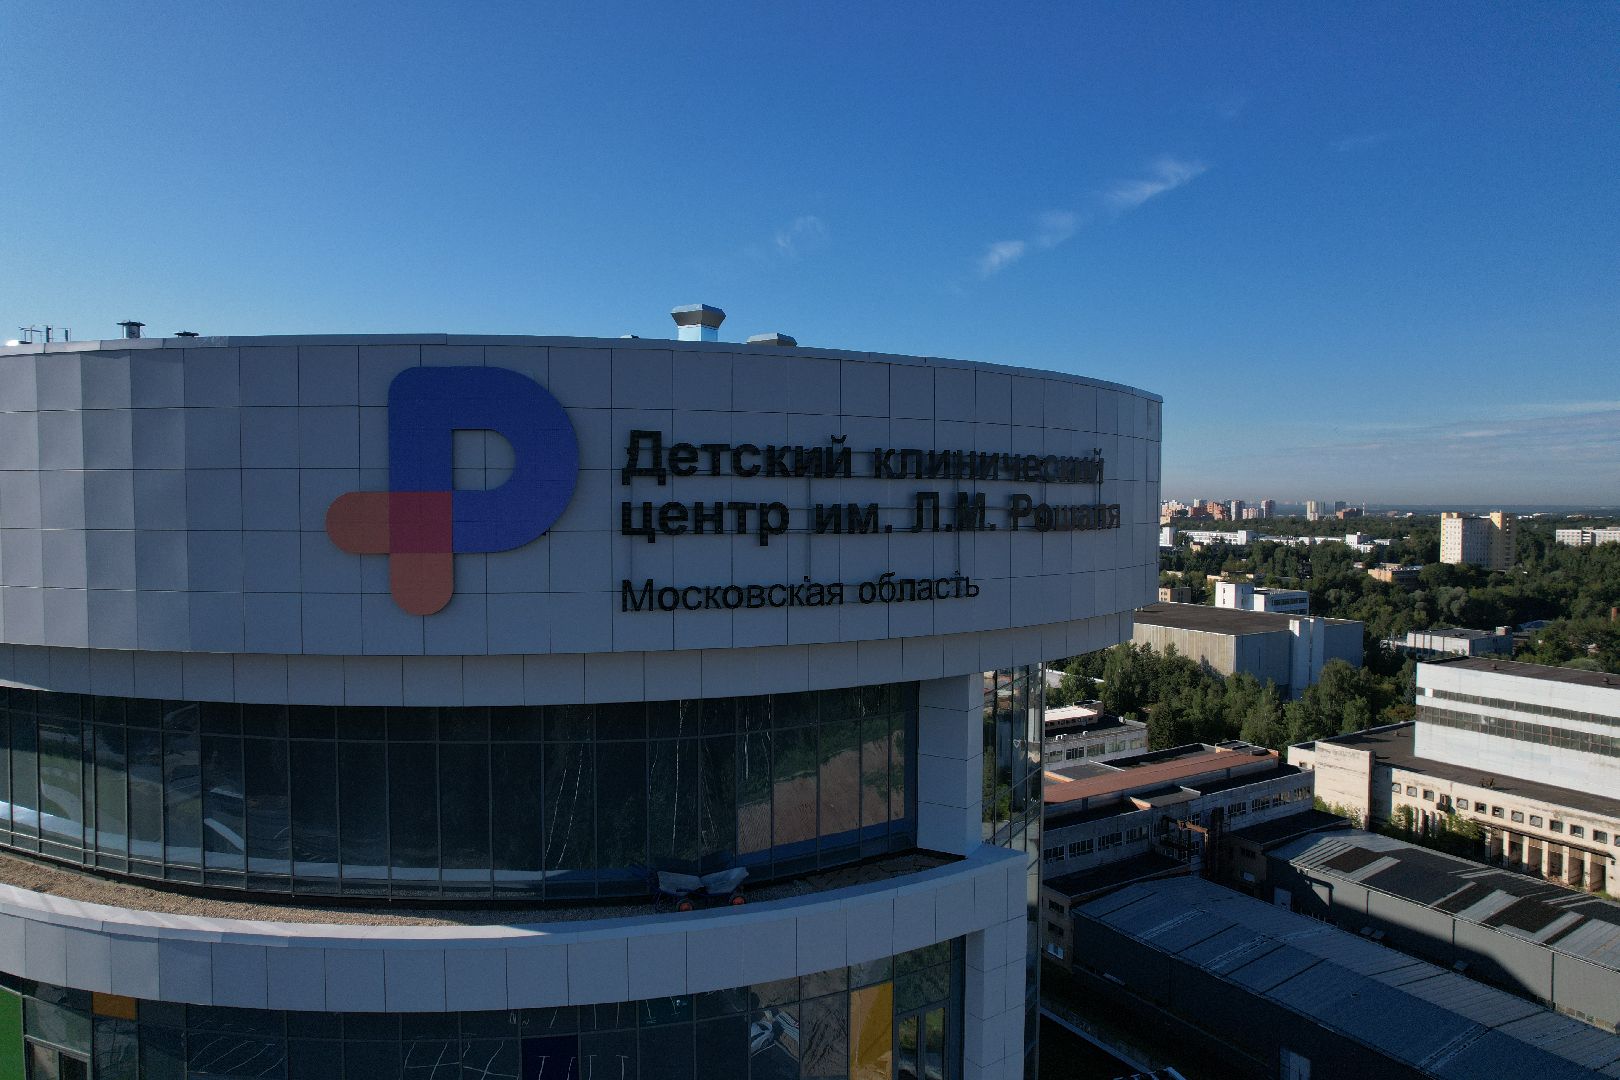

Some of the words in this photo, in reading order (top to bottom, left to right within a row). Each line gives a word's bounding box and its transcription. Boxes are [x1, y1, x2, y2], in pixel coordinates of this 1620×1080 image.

[621, 430, 852, 485] Детский
[874, 448, 1105, 485] клинический
[621, 501, 790, 546] центр
[814, 503, 893, 534] им.
[911, 491, 997, 533] Л.М.
[1009, 493, 1121, 532] Рошаля
[622, 578, 844, 612] Московская
[858, 572, 980, 604] область
